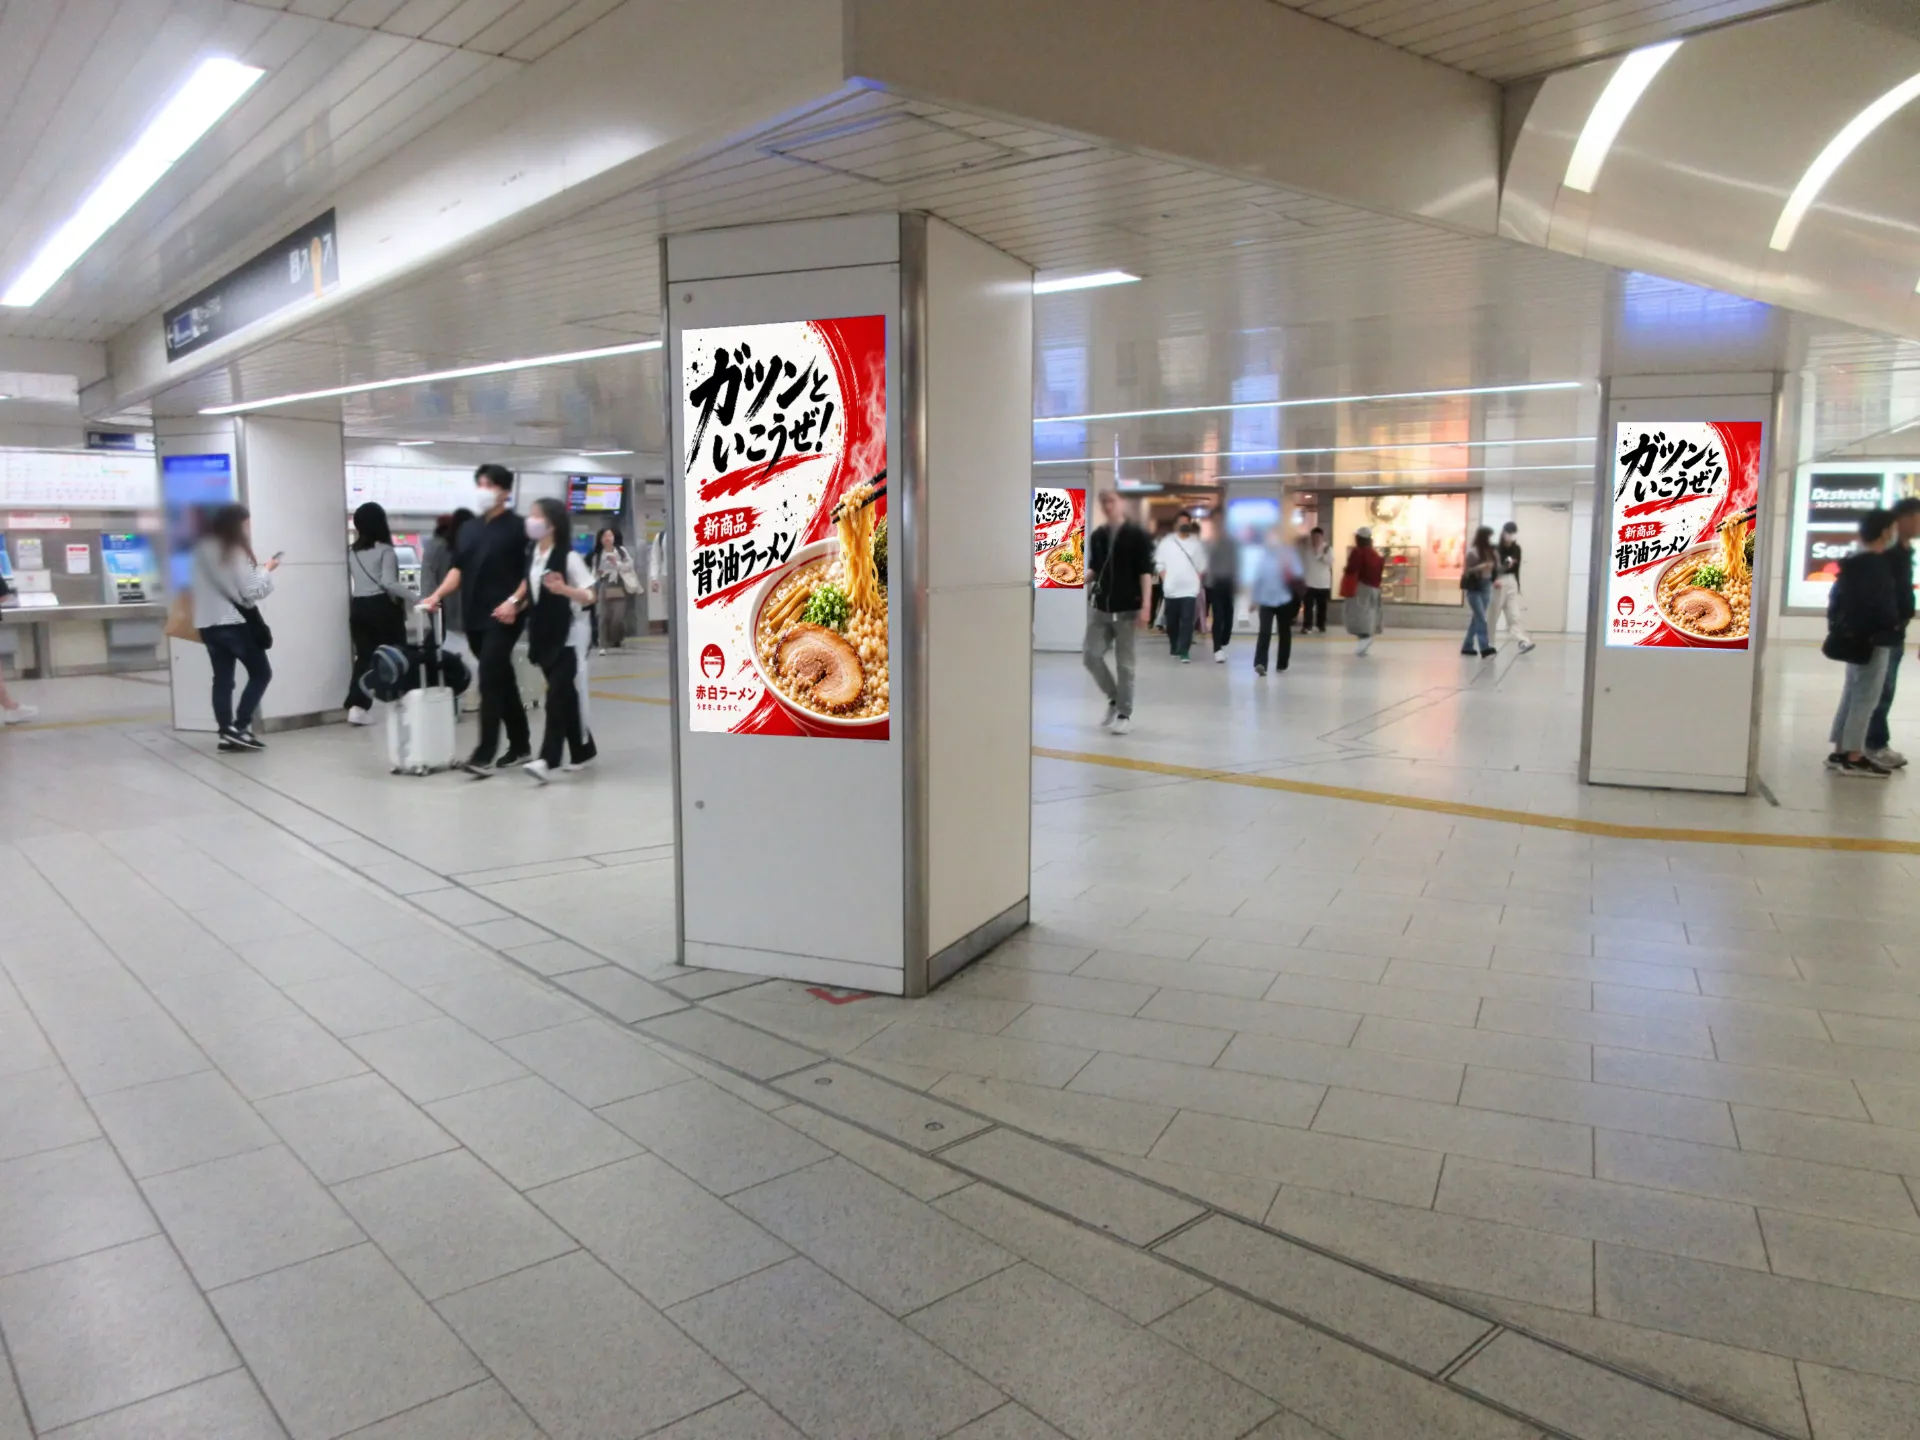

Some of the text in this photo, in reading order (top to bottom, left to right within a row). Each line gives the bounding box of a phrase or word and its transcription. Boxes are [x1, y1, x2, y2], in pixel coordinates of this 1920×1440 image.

[686, 342, 829, 475] ガツンと
[1614, 431, 1720, 503] ガツンと
[1035, 491, 1070, 513] ガツンと
[703, 511, 748, 541] 新商品
[1624, 522, 1656, 540] 新商品
[692, 529, 798, 597] 背油ラーメン
[1615, 534, 1692, 571] 背油ラーメン
[1613, 618, 1656, 628] 赤白ラーメン
[696, 685, 757, 701] 赤白ラーメン
